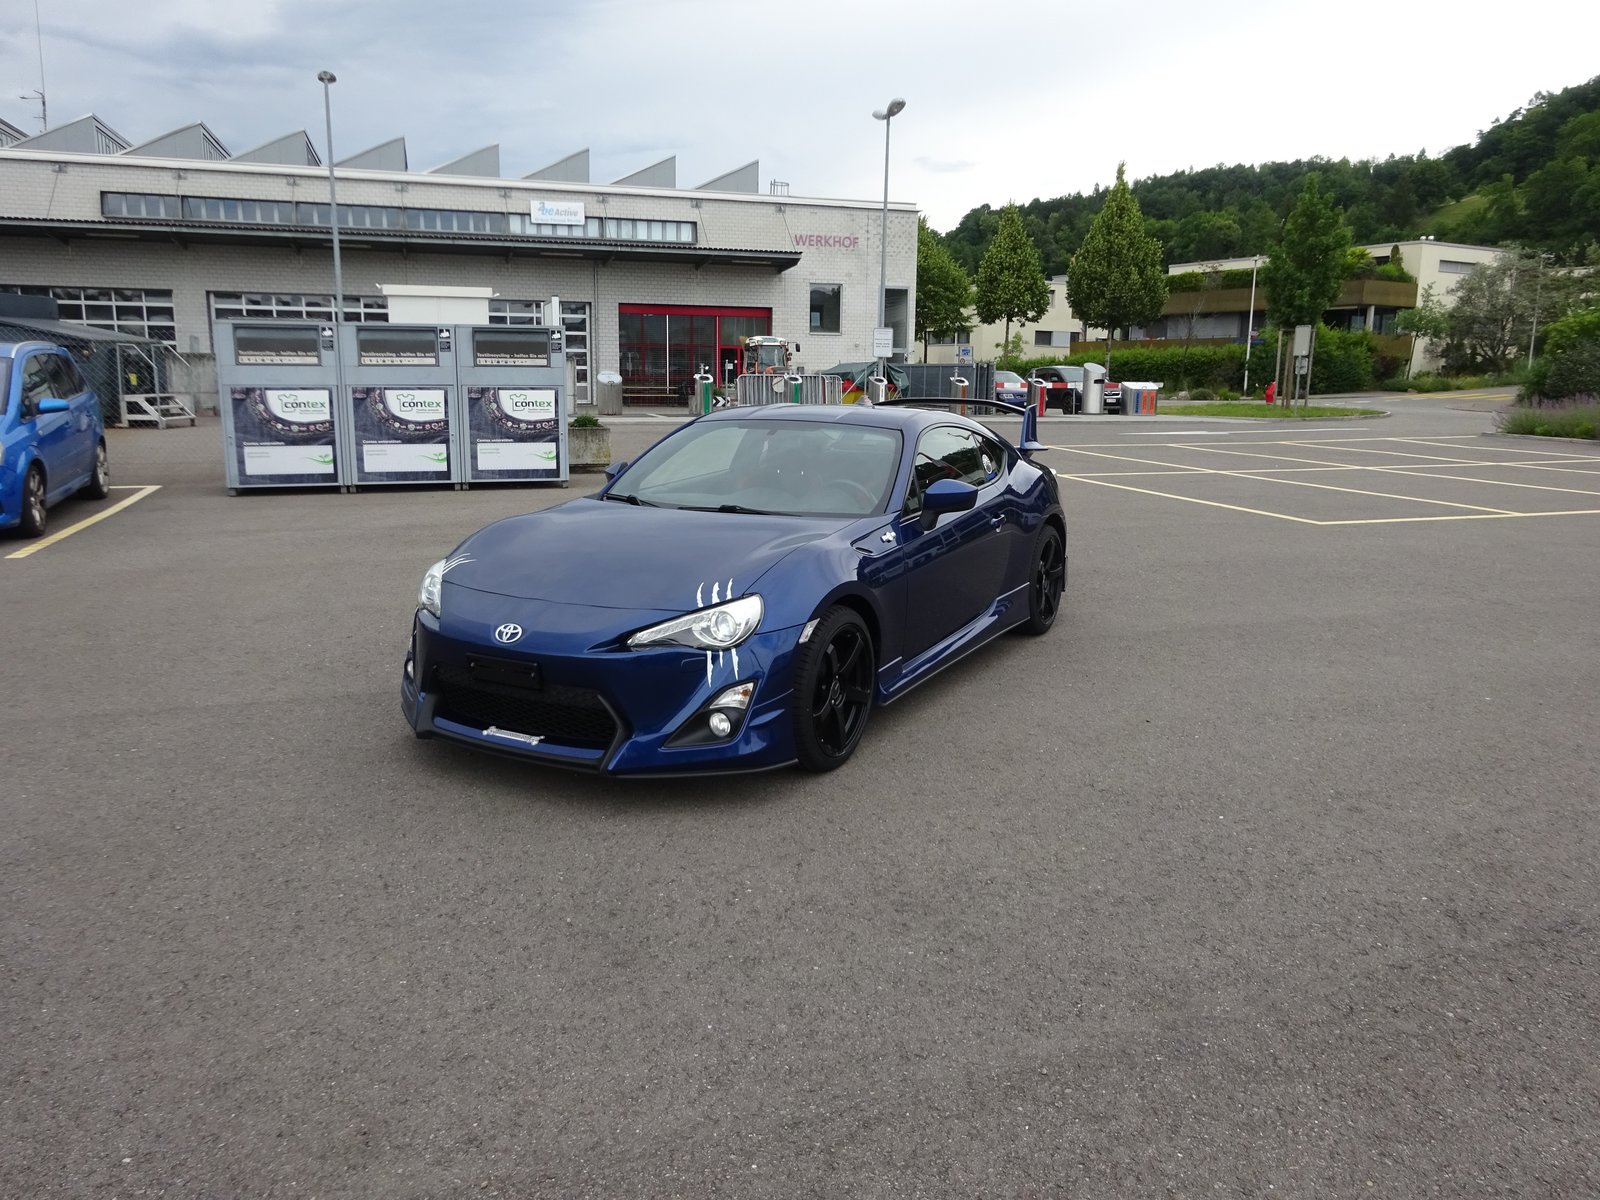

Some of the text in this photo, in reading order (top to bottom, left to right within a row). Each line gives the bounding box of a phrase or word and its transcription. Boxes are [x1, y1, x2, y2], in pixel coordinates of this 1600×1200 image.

[554, 207, 579, 217] Active
[795, 234, 859, 249] WERKHOF
[284, 401, 326, 409] contex
[402, 400, 442, 408] contex
[514, 400, 552, 408] contex
